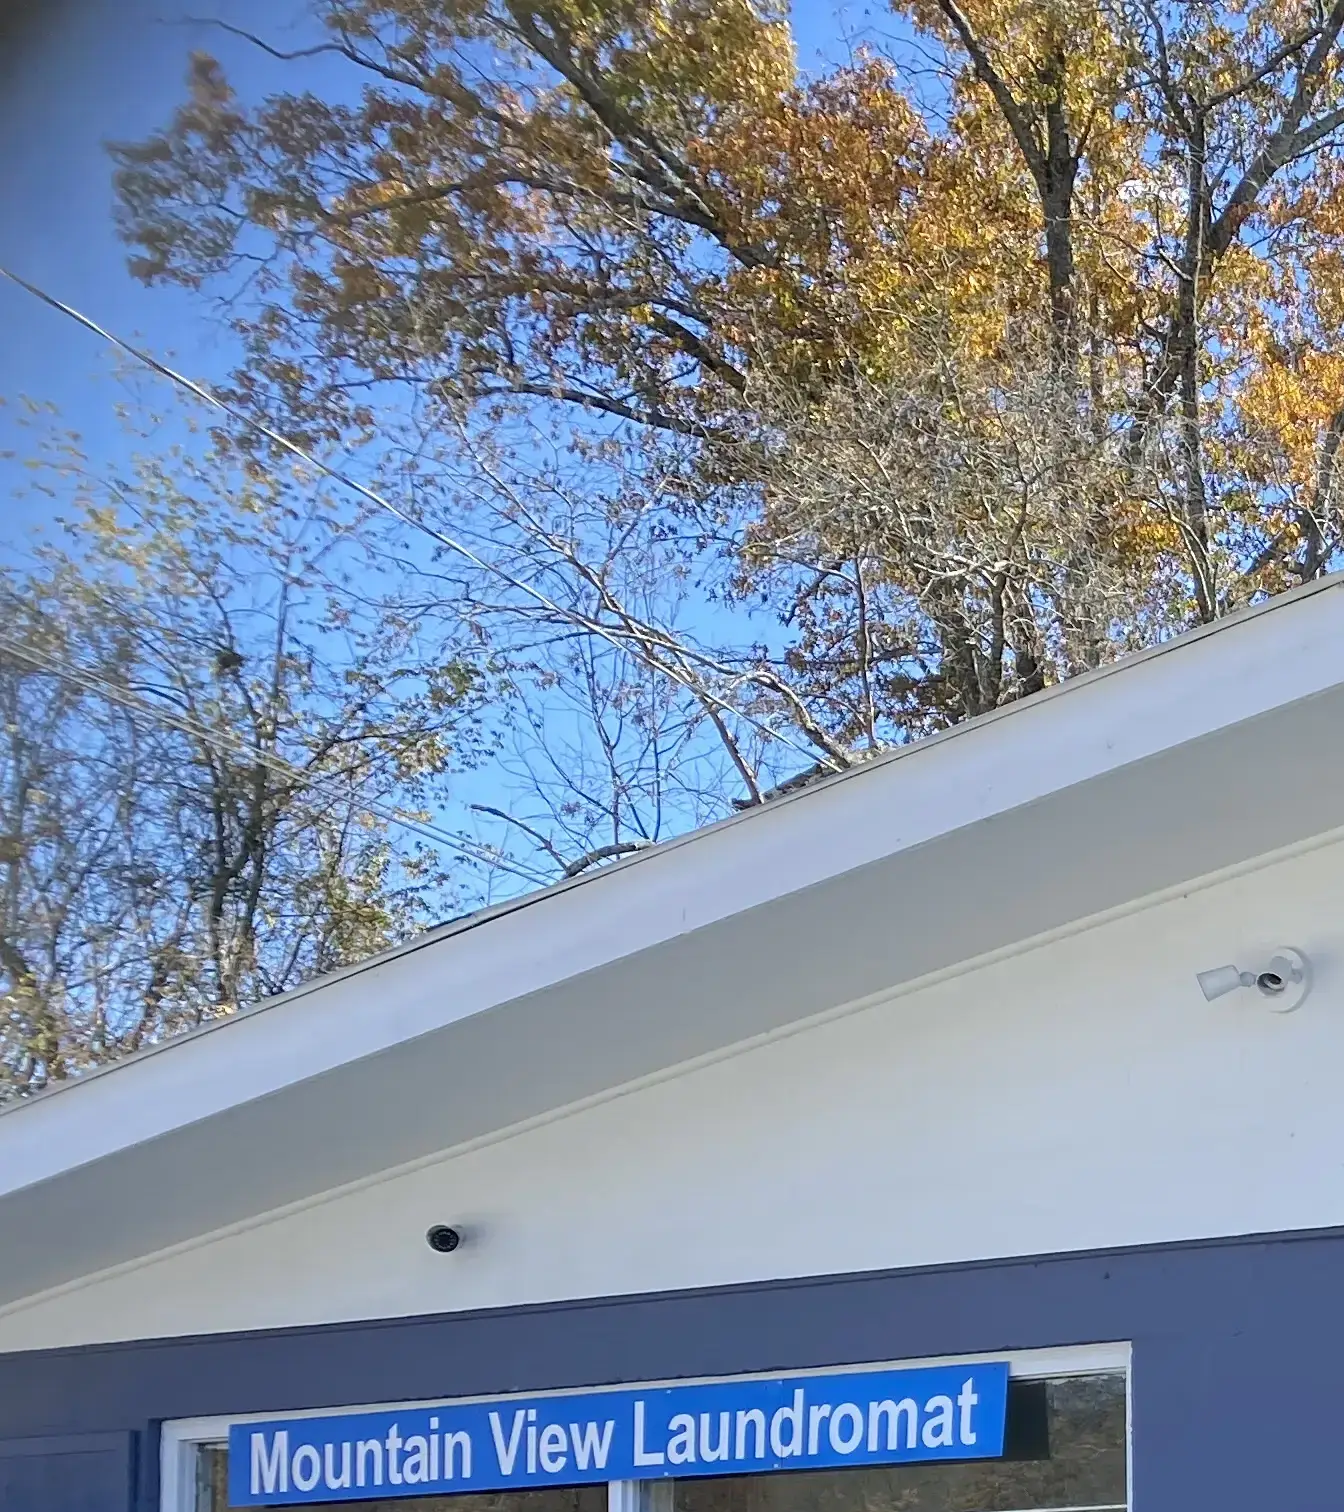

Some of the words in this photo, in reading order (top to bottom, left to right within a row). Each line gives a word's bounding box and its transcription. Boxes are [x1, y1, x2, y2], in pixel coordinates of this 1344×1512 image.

[249, 1417, 472, 1495] Mountain
[488, 1409, 615, 1475] View
[633, 1376, 979, 1467] Laundromat
